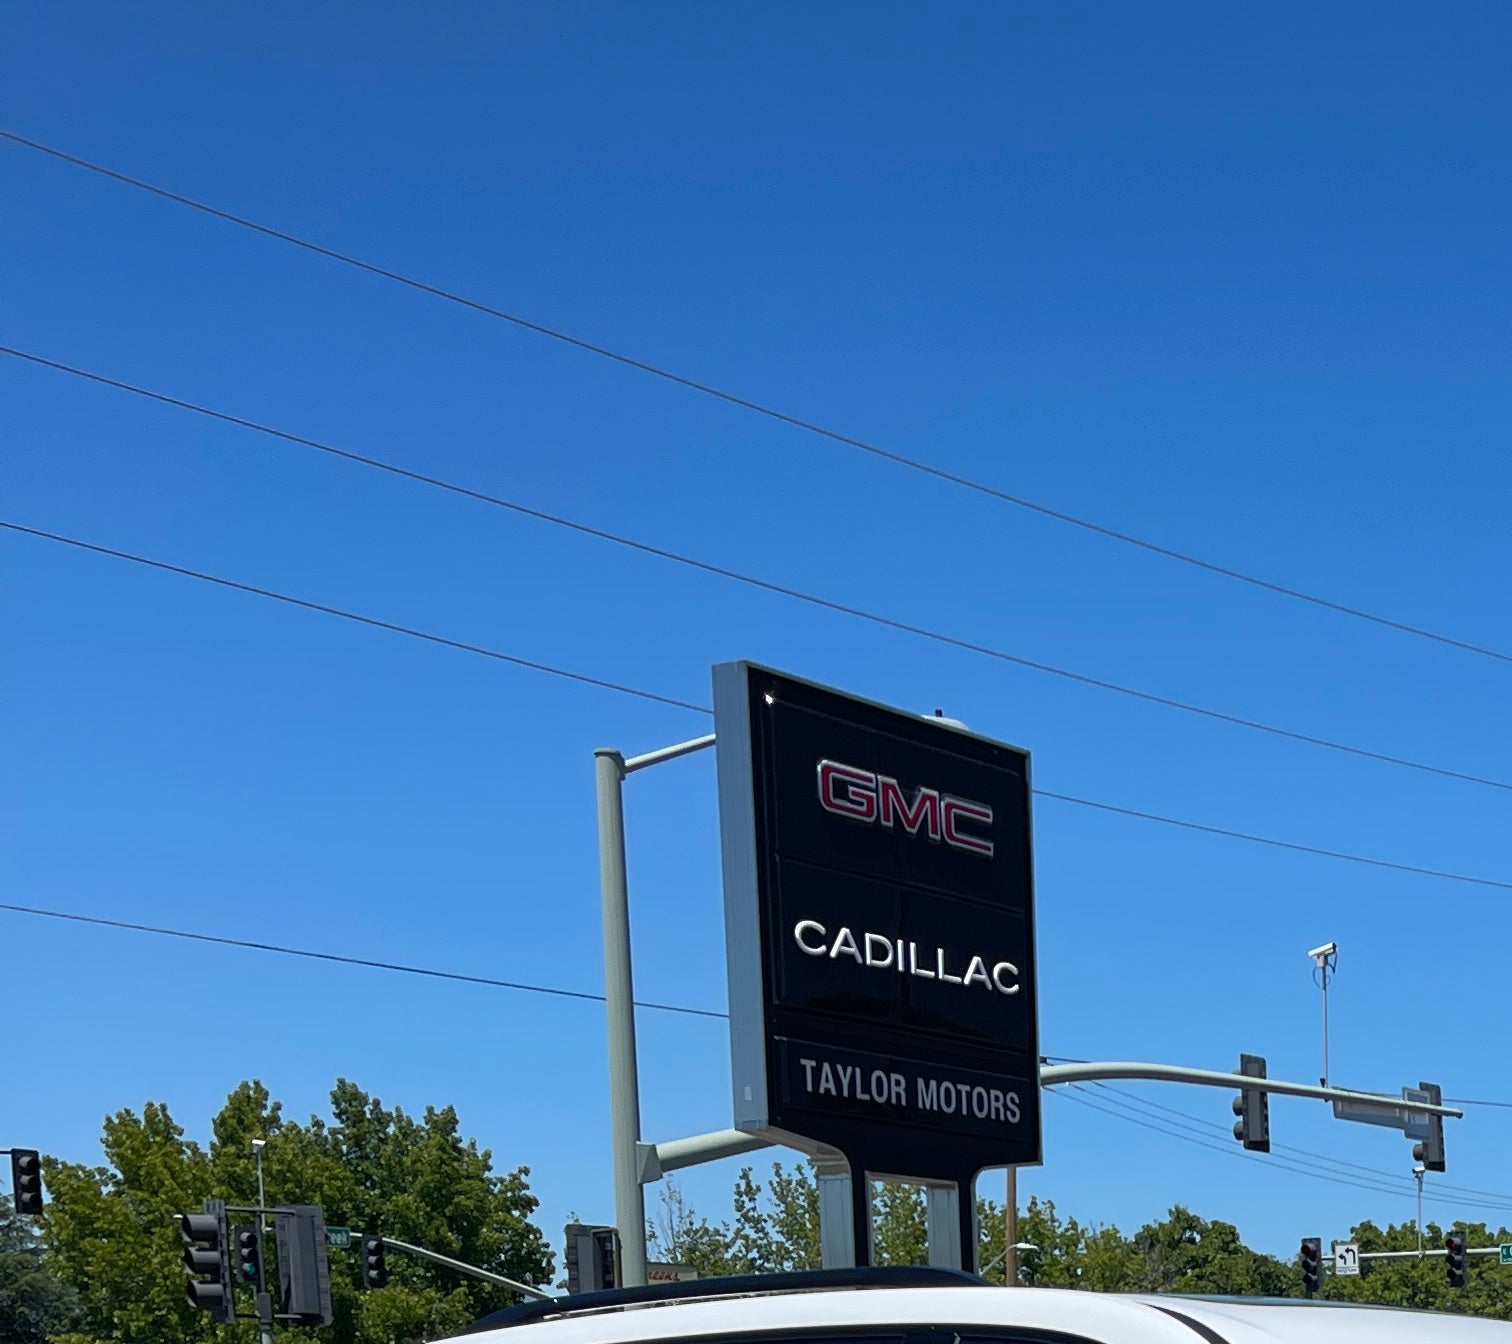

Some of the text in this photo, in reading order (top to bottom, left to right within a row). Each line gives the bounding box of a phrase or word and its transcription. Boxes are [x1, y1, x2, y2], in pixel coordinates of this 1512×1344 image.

[816, 759, 993, 857] GMC
[794, 920, 1020, 994] CADILLAC
[800, 1059, 1020, 1124] TAYLOR MOTORS
